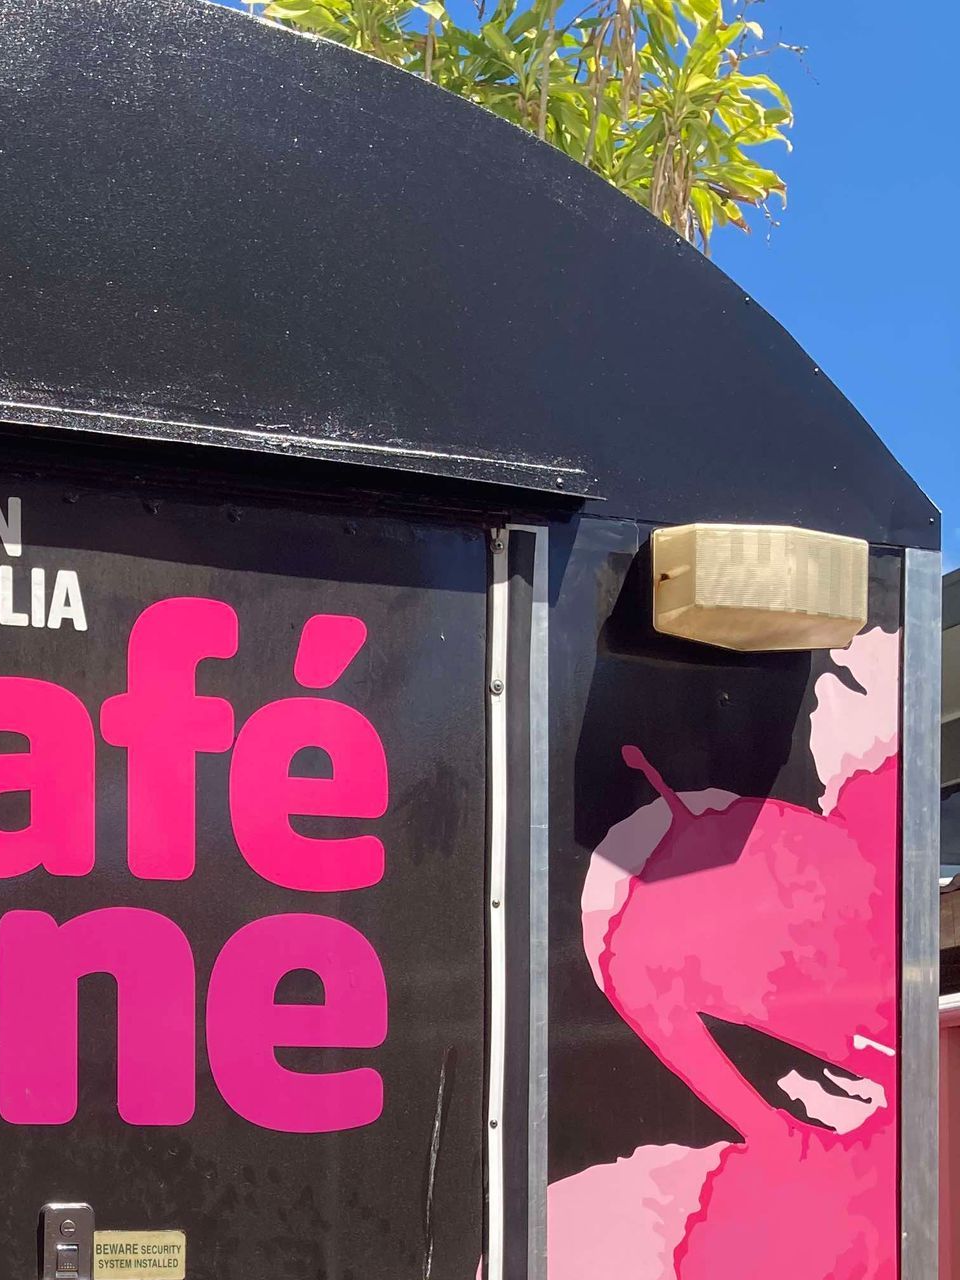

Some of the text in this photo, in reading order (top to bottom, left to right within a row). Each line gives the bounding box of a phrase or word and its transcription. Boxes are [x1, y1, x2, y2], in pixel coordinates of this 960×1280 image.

[95, 1243, 181, 1255] BEWARE SECURITY
[98, 1258, 179, 1269] SYSTEM INSTALLED
